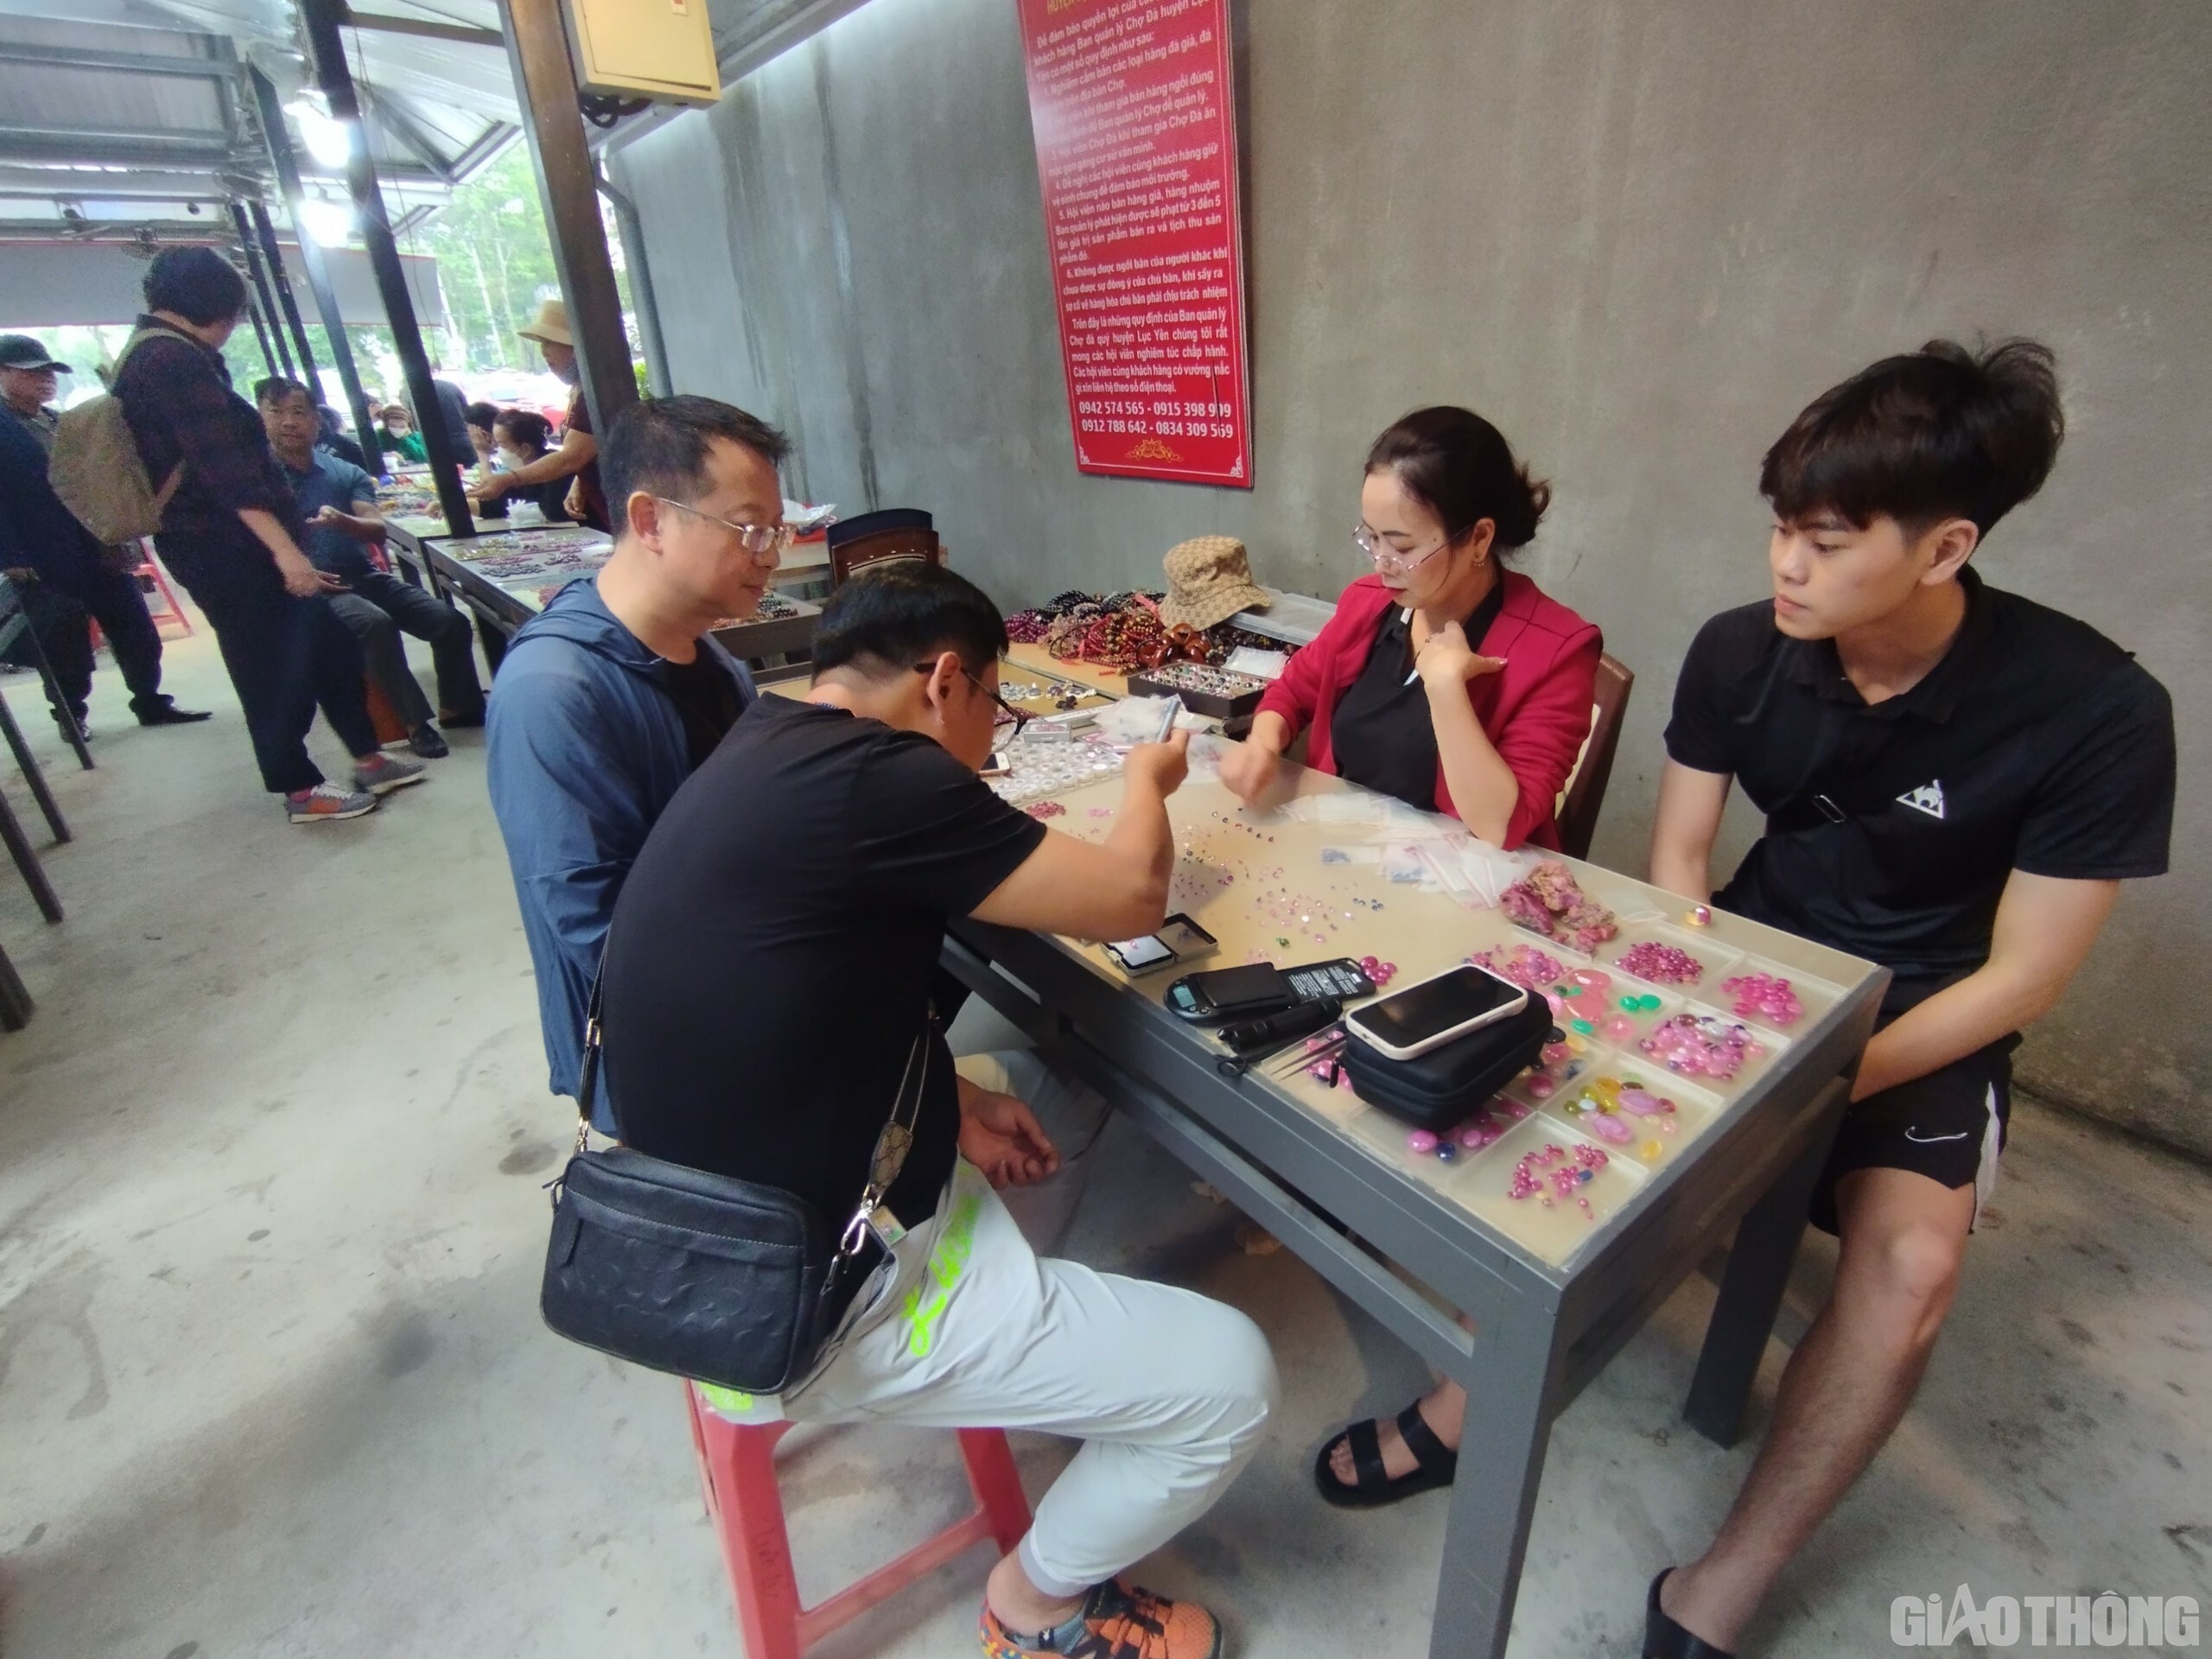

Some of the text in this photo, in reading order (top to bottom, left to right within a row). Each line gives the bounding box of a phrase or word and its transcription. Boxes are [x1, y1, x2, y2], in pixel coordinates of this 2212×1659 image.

[1132, 315, 1145, 327] quy
[1146, 311, 1163, 327] định
[1164, 309, 1178, 322] của
[1179, 309, 1195, 321] Ban
[1197, 308, 1217, 324] quản
[1218, 306, 1227, 322] lý
[1137, 330, 1152, 344] Lục
[1154, 328, 1169, 340] Yên
[1173, 327, 1198, 342] chúng
[1201, 327, 1212, 339] tôi
[1216, 323, 1228, 339] rất
[1119, 348, 1135, 359] viên
[1137, 346, 1164, 361] nghiêm
[1166, 346, 1179, 359] túc
[1182, 343, 1202, 360] chấp
[1205, 345, 1229, 357] hành.
[1131, 364, 1152, 376] khách
[1153, 364, 1173, 378] hàng
[1173, 363, 1183, 375] có
[1184, 363, 1211, 378] vướng
[1129, 378, 1139, 392] số
[1140, 381, 1154, 395] điện
[1156, 381, 1177, 394] thoại.
[1079, 401, 1103, 414] 0942
[1104, 401, 1123, 415] 574
[1125, 402, 1144, 415] 565
[1154, 402, 1181, 416] 0915
[1184, 402, 1206, 416] 398
[1082, 419, 1105, 432] 0912
[1107, 419, 1126, 433] 788
[1128, 420, 1147, 434] 642
[1156, 421, 1183, 435] 0834
[1186, 422, 1208, 437] 309
